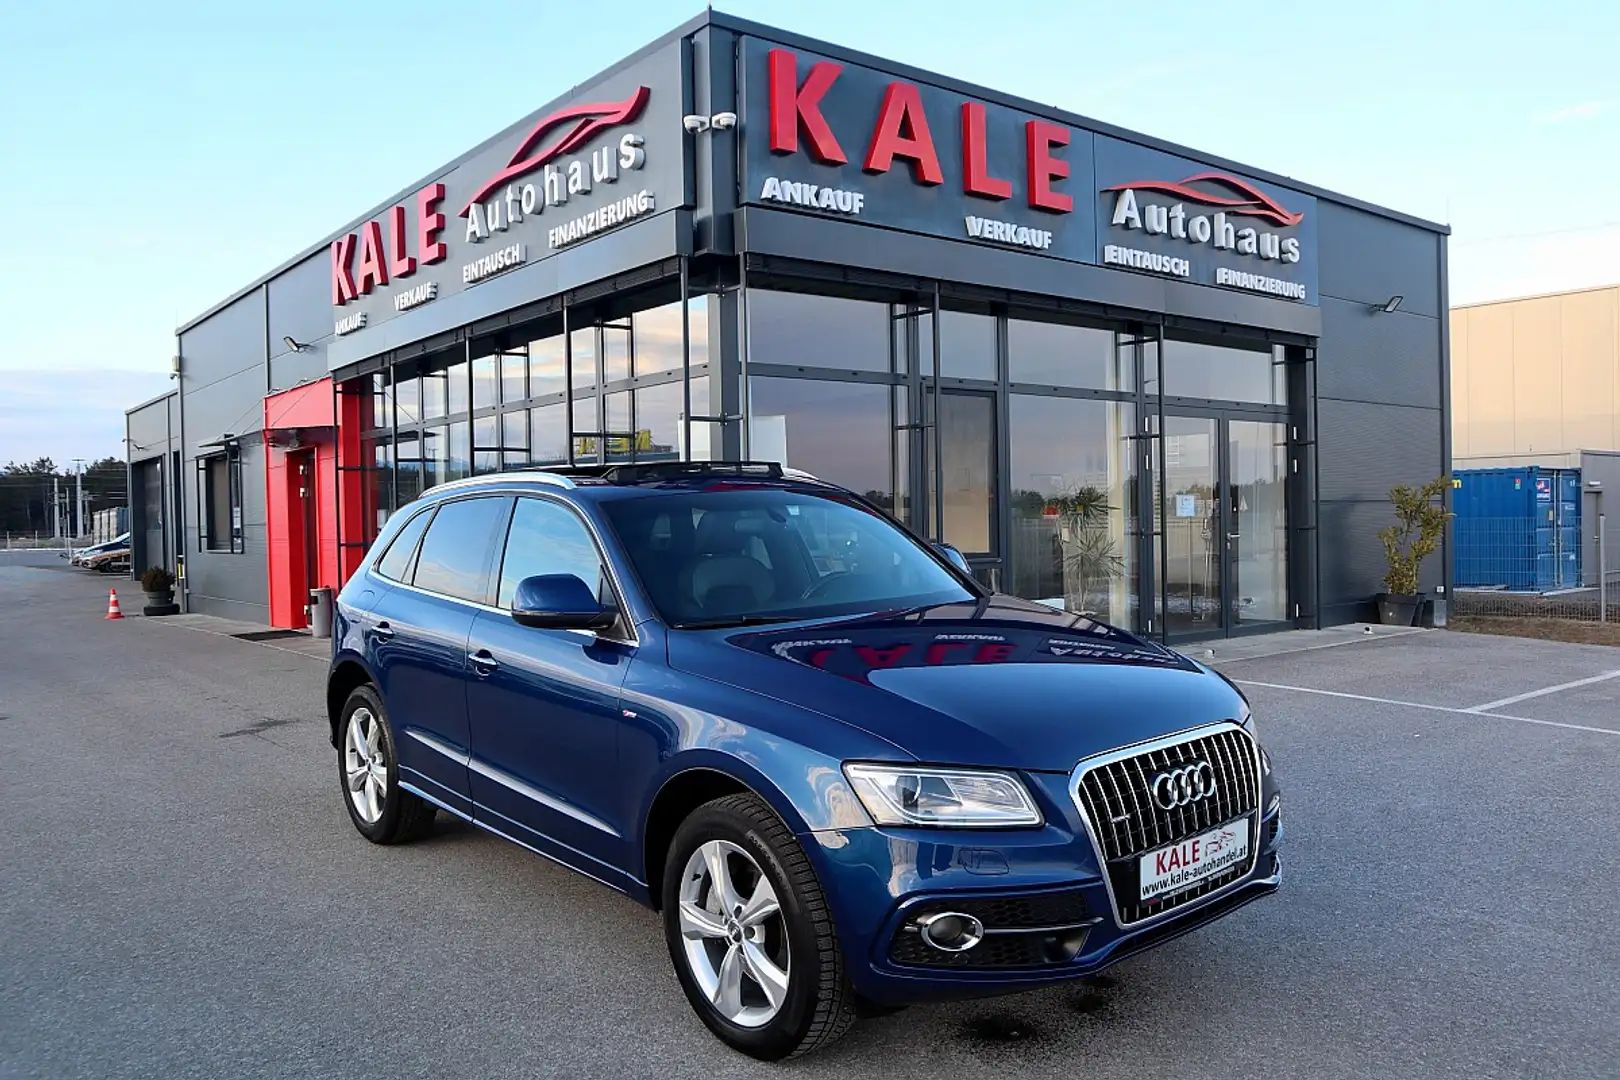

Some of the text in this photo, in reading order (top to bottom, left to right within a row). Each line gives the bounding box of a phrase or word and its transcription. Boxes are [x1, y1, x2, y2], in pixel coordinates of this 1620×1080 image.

[768, 48, 1074, 214] KALE
[465, 133, 646, 244] Autohaus
[759, 176, 1052, 249] ANKAUF VERKAUF
[1112, 188, 1300, 264] Autohaus
[331, 183, 447, 306] KALE
[463, 189, 655, 284] EINTAUSCH FINANZIERUNG
[1104, 244, 1306, 300] EINTAUSCH FINANZIERUNG
[394, 281, 438, 311] VERKAUF
[1156, 840, 1201, 876] KALE
